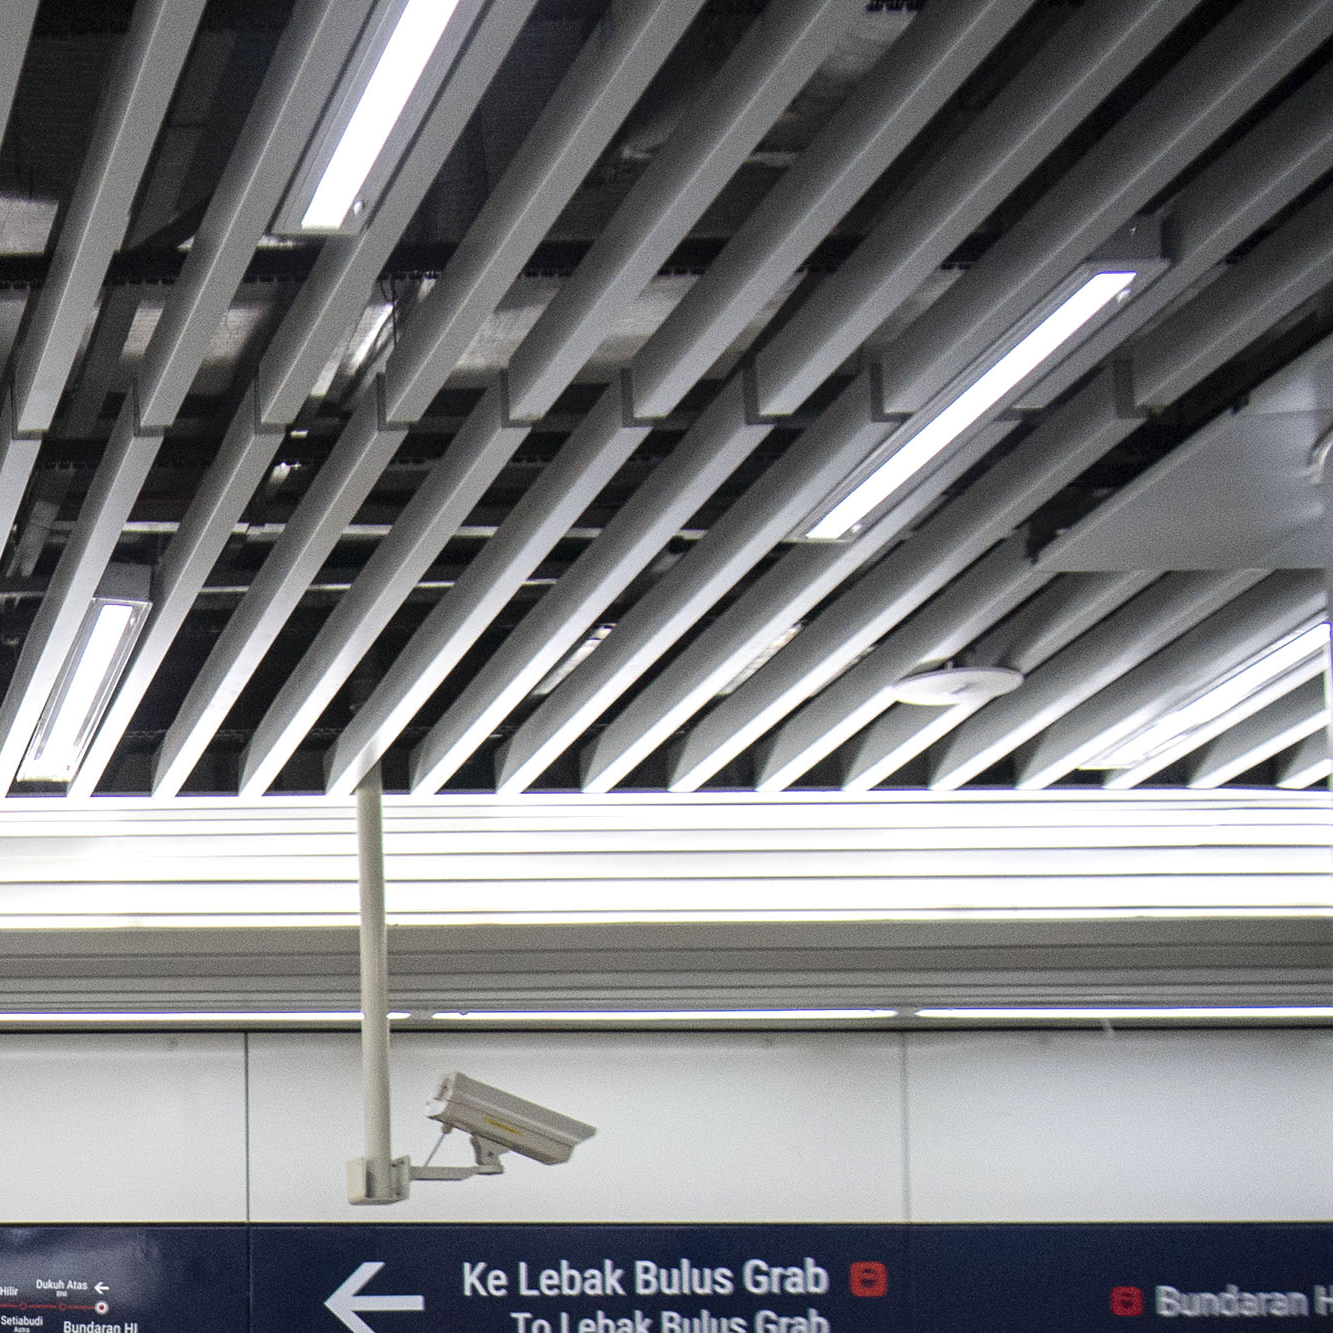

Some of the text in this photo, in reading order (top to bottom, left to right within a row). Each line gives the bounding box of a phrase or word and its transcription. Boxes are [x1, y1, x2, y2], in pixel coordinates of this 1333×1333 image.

[462, 1257, 830, 1297] Ke Lebak Bulus Grab
[0, 1284, 19, 1297] Hilir
[35, 1279, 88, 1291] Dukuh Atas
[1154, 1284, 1309, 1317] Bundaran
[0, 1314, 44, 1327] Setiabudi
